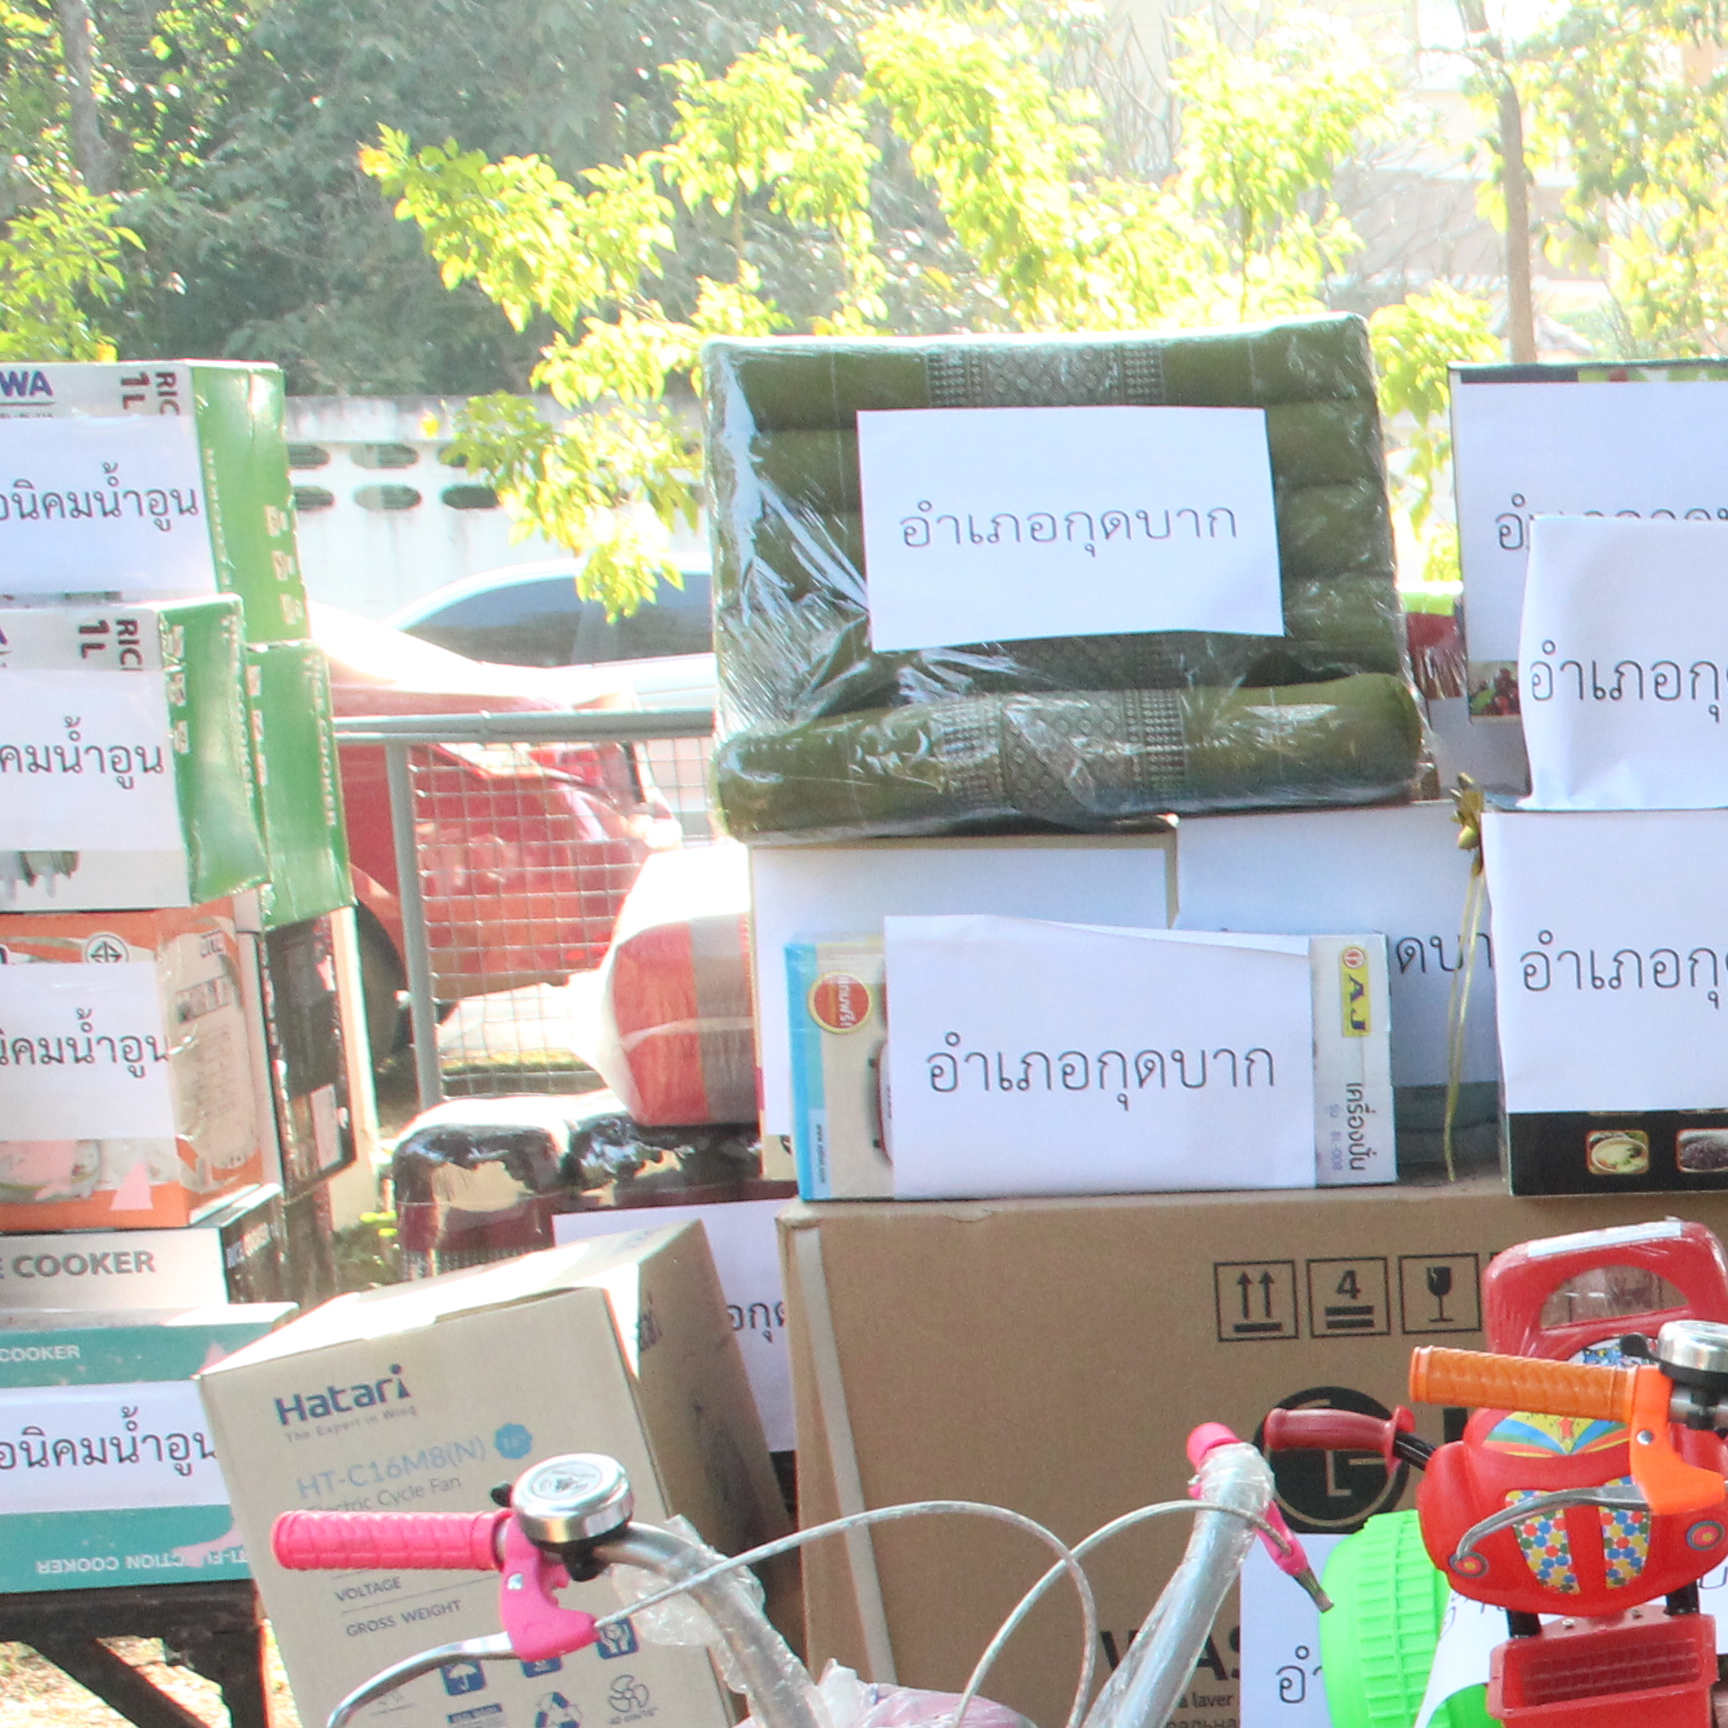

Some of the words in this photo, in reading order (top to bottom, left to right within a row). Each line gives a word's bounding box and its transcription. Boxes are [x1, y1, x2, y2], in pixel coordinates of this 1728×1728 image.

[900, 500, 1238, 557] อำเภอกุดบาก
[926, 1032, 1275, 1111] อำเภอกุดบาก
[13, 1251, 155, 1278] COOKER
[1335, 1270, 1360, 1299] 4
[275, 1363, 412, 1425] Hatari
[297, 1437, 486, 1501] HT-C16M8(N)
[377, 1484, 425, 1507] Cycle
[430, 1477, 462, 1495] Fan
[35, 1556, 119, 1576] COOKER
[335, 1577, 402, 1602] VOLTAGE
[346, 1615, 397, 1637] GROSS
[400, 1599, 462, 1624] WEIGHT
